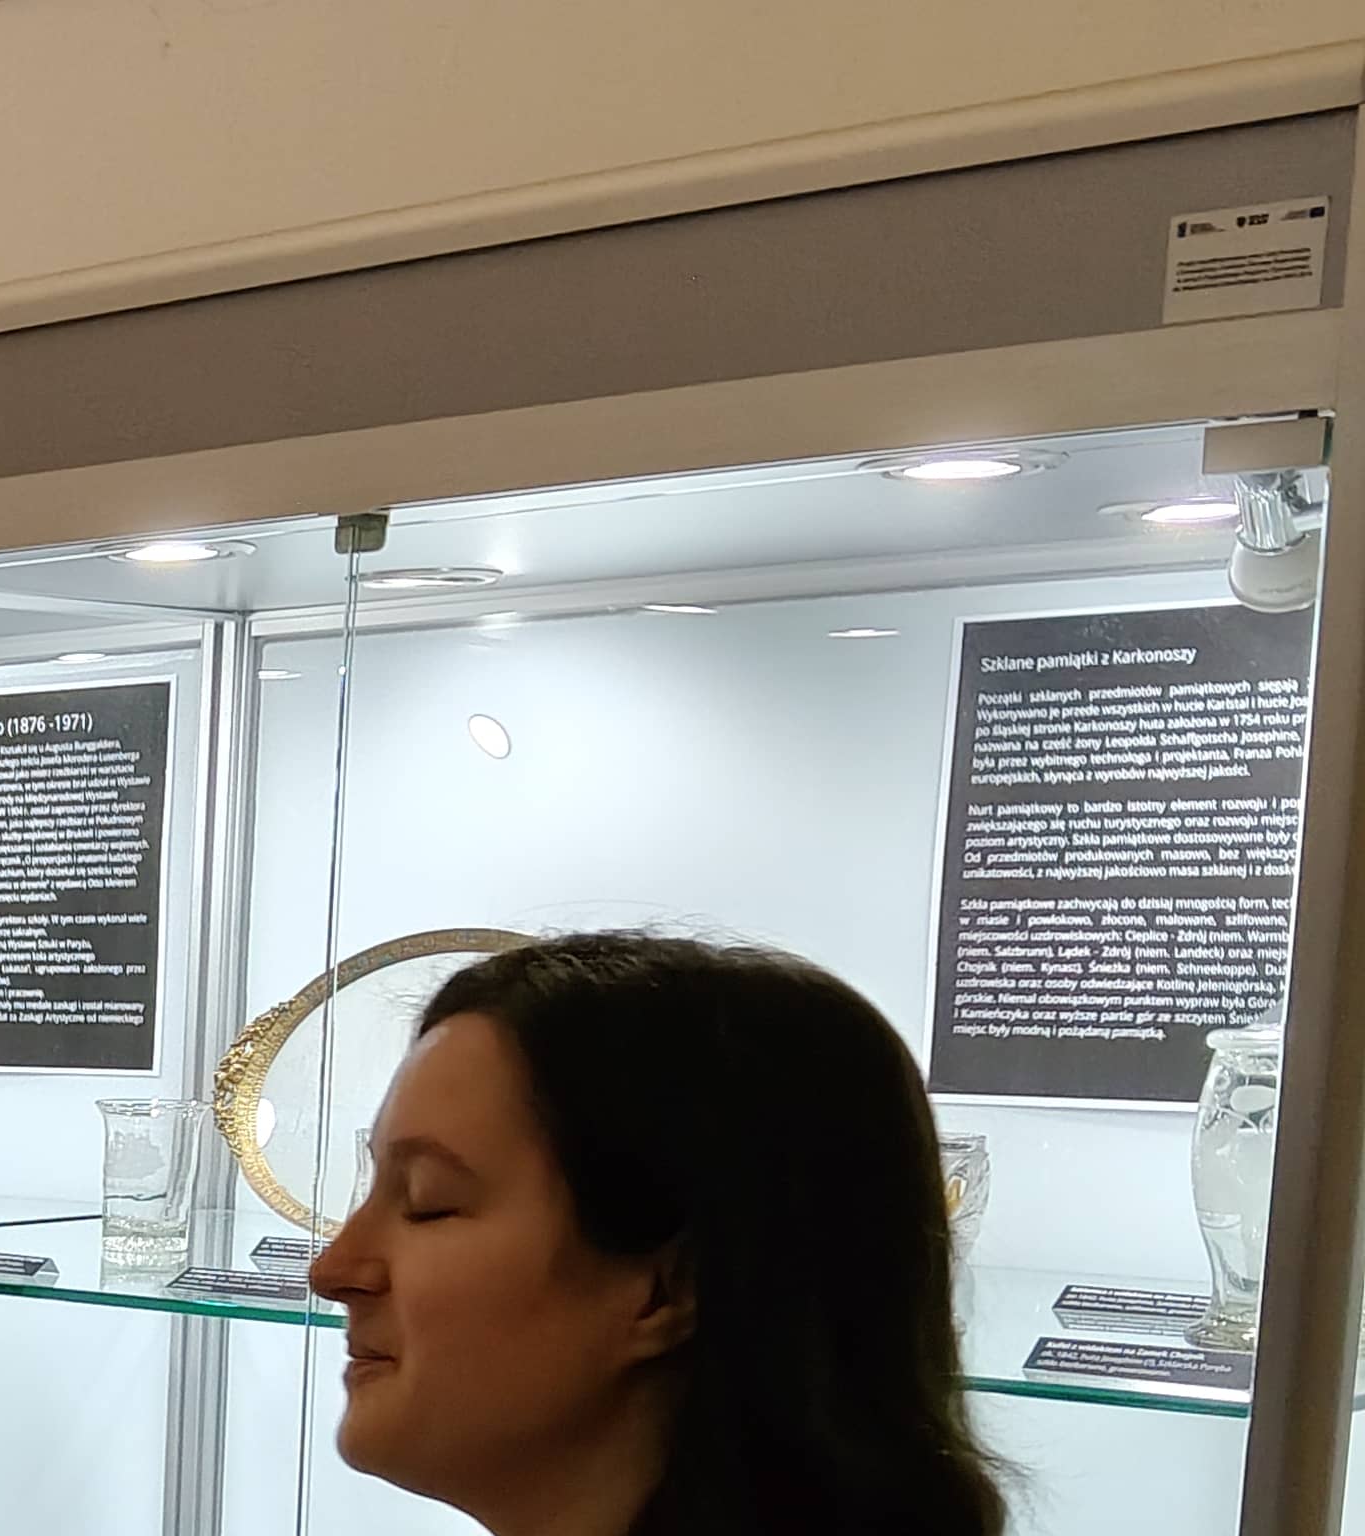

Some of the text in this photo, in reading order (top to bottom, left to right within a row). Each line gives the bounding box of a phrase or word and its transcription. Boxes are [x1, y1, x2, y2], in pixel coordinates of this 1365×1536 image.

[980, 654, 1035, 672] Szklane
[1035, 650, 1099, 670] pamiątki
[1111, 645, 1197, 666] Karkonoszy
[6, 714, 46, 737] (1876
